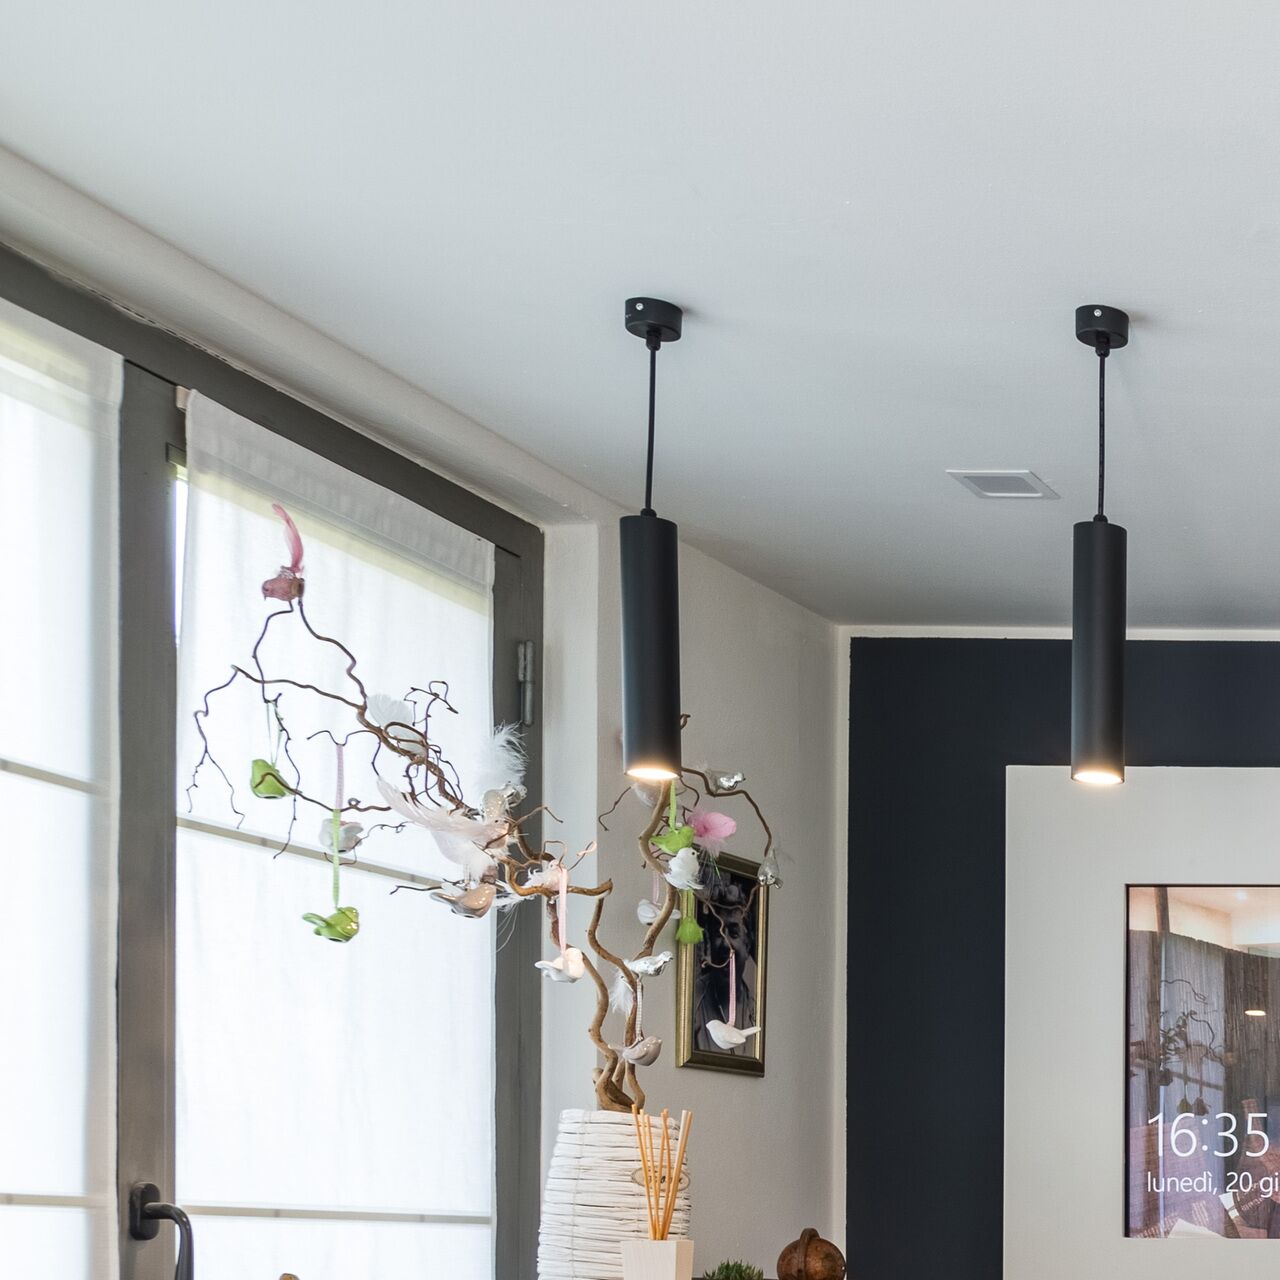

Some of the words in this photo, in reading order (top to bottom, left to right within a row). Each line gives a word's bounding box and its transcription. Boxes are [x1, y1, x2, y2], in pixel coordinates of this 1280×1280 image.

[1148, 1112, 1270, 1157] 16:35
[1146, 1171, 1219, 1196] lunedì,
[1225, 1171, 1253, 1193] 20
